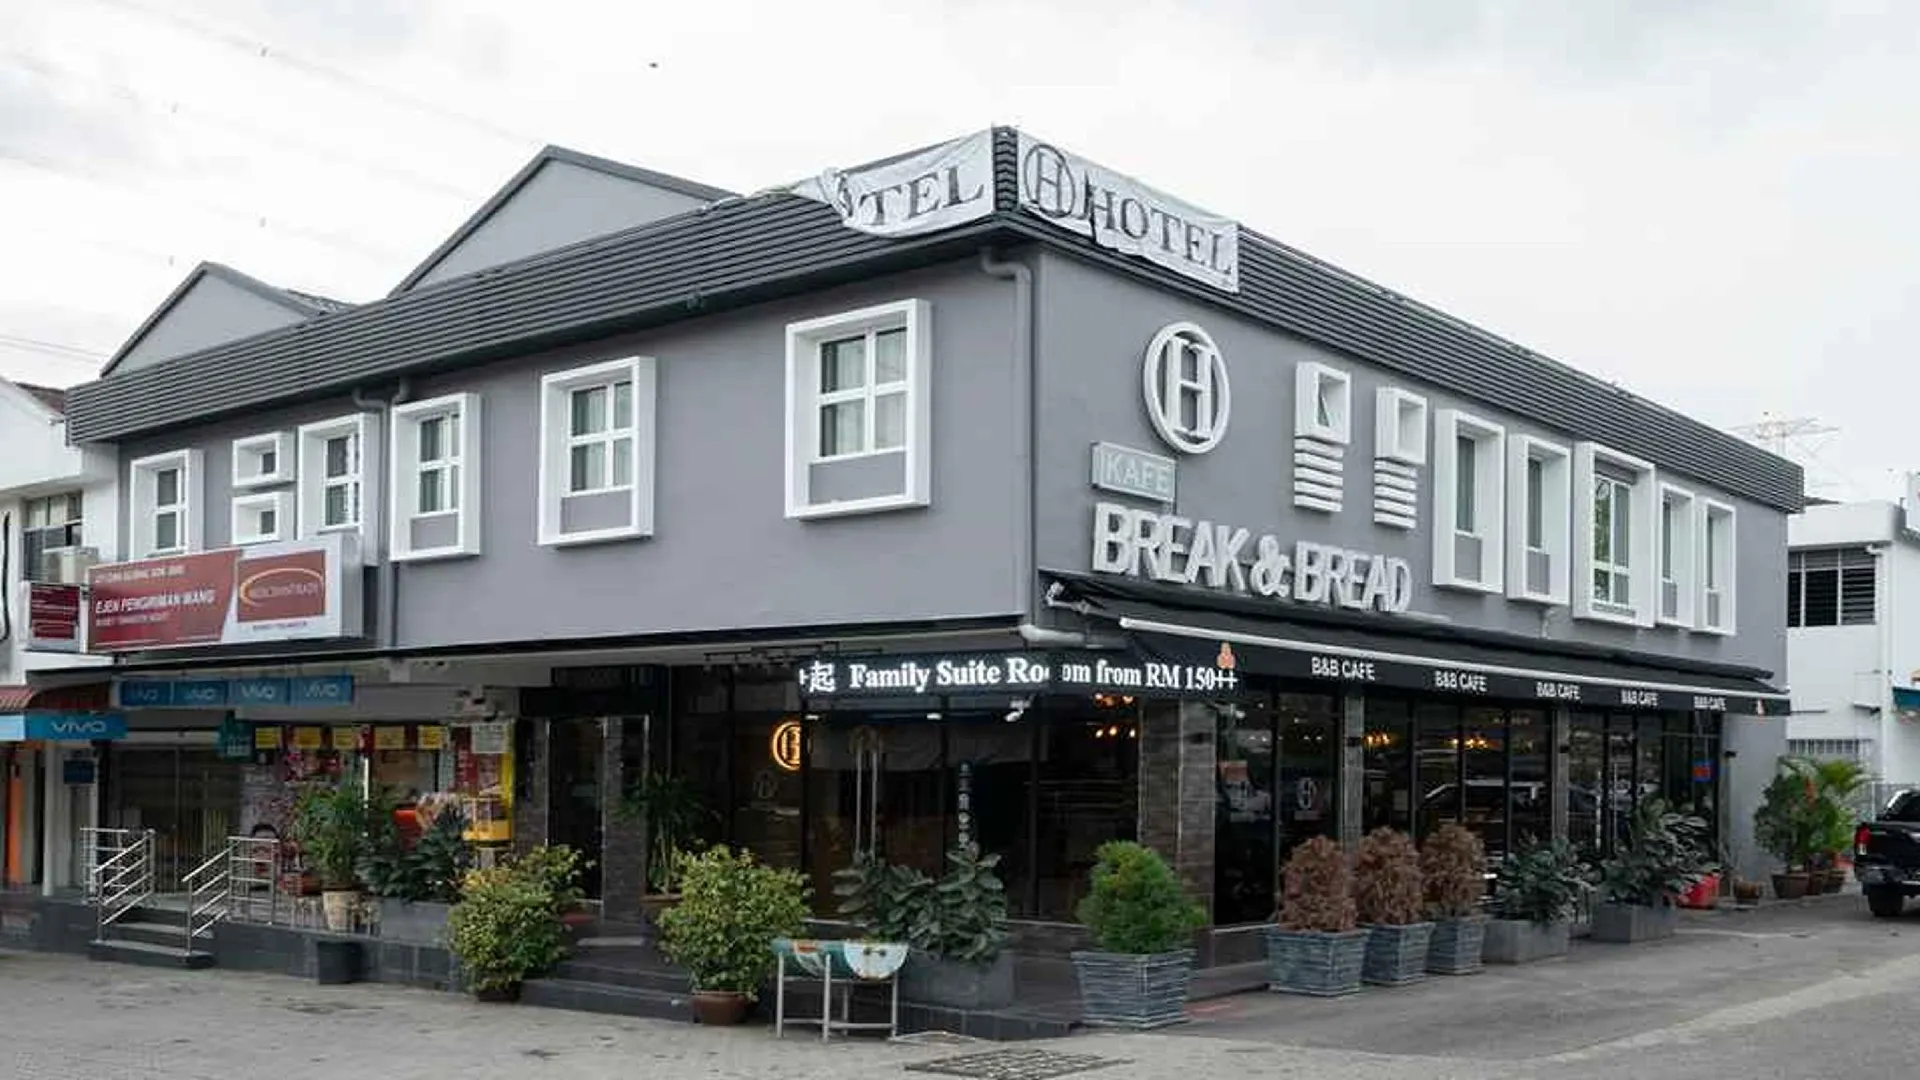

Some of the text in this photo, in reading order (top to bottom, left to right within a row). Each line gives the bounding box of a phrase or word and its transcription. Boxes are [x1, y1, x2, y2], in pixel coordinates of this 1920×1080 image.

[1079, 171, 1233, 275] HOTEL
[1105, 451, 1173, 495] KAFE
[1092, 501, 1413, 613] BREAK & BREAD
[849, 662, 931, 694] Family
[936, 659, 1001, 686] Suite
[1096, 658, 1143, 685] from
[1145, 662, 1182, 689] RM
[1186, 666, 1239, 690] 150++
[1311, 656, 1376, 682] B&B CAFE
[1435, 670, 1488, 692] B&B CAFE
[1557, 683, 1581, 700] CAFE
